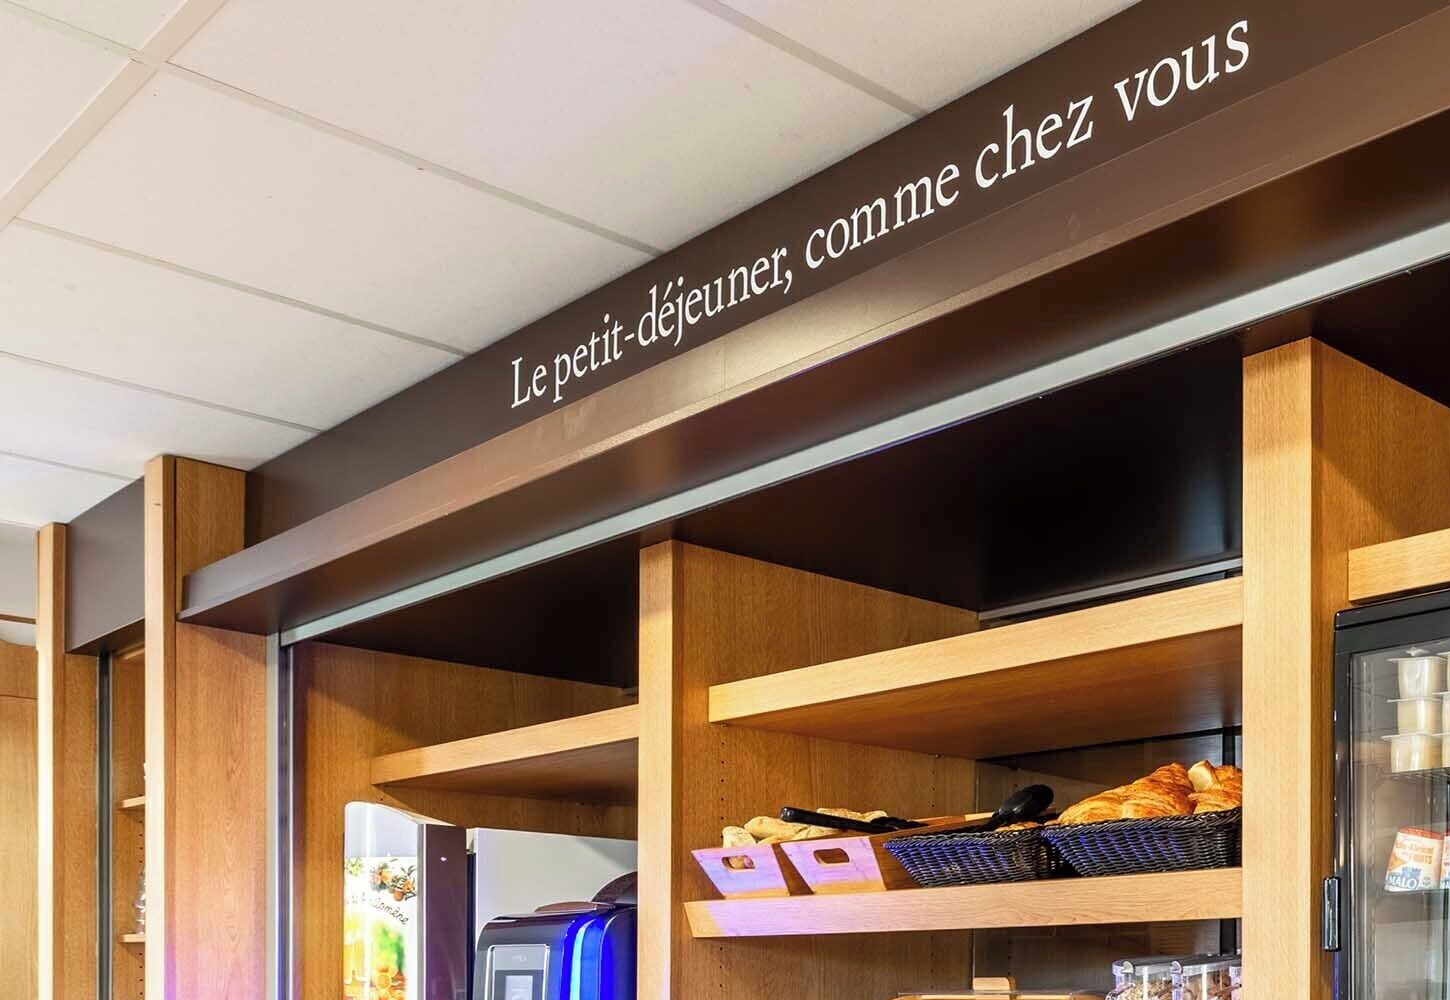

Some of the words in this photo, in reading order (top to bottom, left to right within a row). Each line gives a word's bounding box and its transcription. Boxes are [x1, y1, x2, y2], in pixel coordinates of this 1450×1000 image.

[511, 356, 547, 408] Le
[552, 246, 794, 404] petit-déjeuner,
[805, 164, 960, 269] comme
[975, 94, 1095, 189] chez
[1113, 20, 1250, 122] vous
